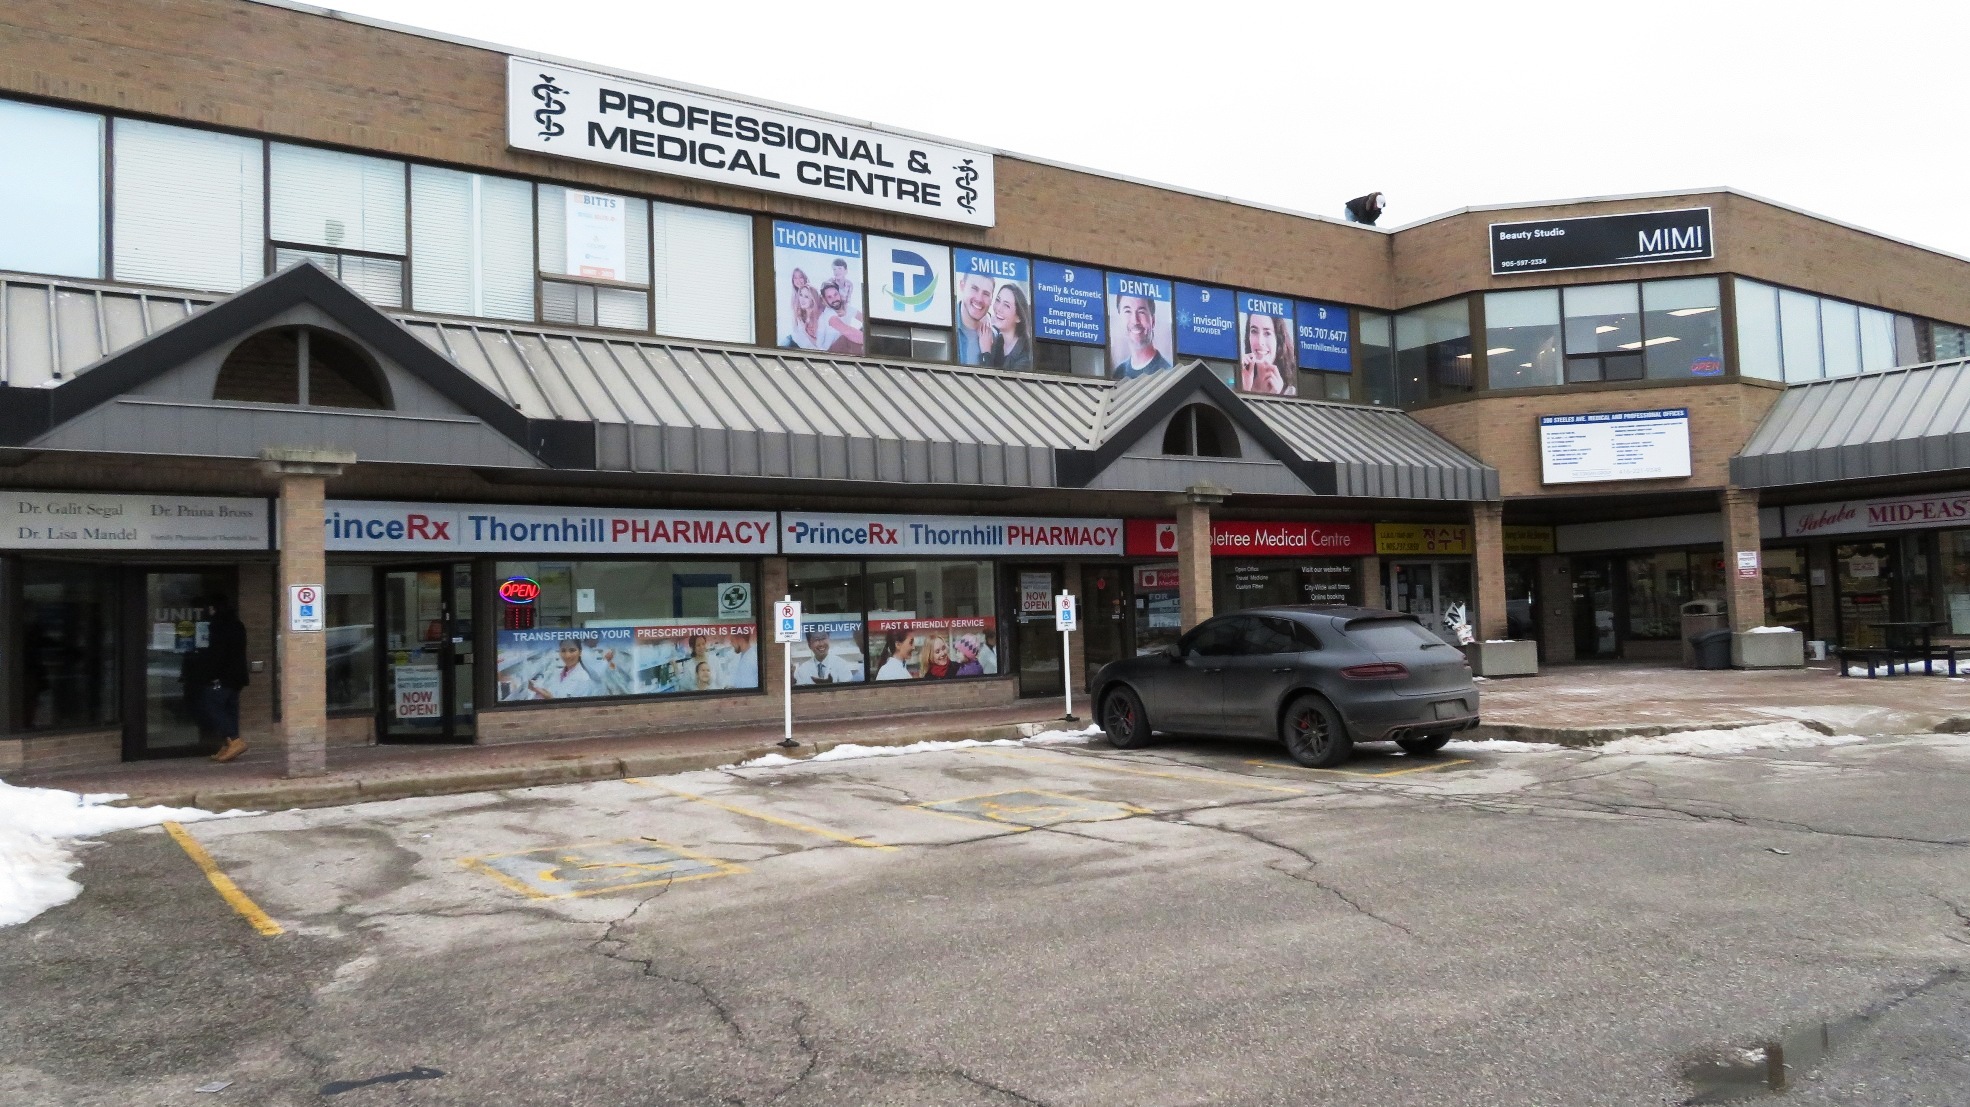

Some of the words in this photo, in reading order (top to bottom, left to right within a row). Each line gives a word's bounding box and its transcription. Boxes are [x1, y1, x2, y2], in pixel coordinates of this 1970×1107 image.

[598, 87, 895, 168] PROFESSIONAL
[907, 150, 932, 175] &
[588, 121, 781, 179] MEDICAL
[796, 161, 942, 207] CENTRE
[583, 195, 617, 209] BITTS
[776, 227, 859, 255] THORNHILL
[1500, 230, 1532, 241] Beauty
[1534, 227, 1565, 238] Studio
[1638, 225, 1702, 253] MIMI
[971, 256, 1016, 277] SMILES
[1038, 283, 1062, 294] Family
[1070, 288, 1102, 299] Cosmetic
[1120, 279, 1162, 298] DENTAL
[1054, 295, 1087, 308] Dentistry
[1248, 298, 1284, 316] CENTRE
[1048, 308, 1093, 320] Emergencies
[1043, 316, 1067, 326] Dental
[1068, 320, 1099, 331] Implants
[1193, 314, 1232, 330] invisalign
[1044, 326, 1064, 336] Laser
[1066, 328, 1098, 342] Dentistry
[1193, 326, 1221, 336] PROVIDER
[1300, 325, 1347, 342] 905.707.6477
[1300, 340, 1347, 354] Thornhillsmiles.ca
[19, 502, 42, 515] Dr.
[47, 503, 82, 516] Galit
[87, 504, 123, 518] Segal
[151, 504, 172, 517] Dr.
[1868, 499, 1970, 523] MID-EAS
[19, 527, 41, 539] Dr.
[48, 527, 77, 540] Lisa
[83, 528, 137, 540] Mandel
[468, 515, 604, 543] Thornhill
[611, 519, 771, 544] PHARMACY
[789, 521, 898, 545] PrinceRx
[910, 523, 1002, 546] Thornhill
[1008, 526, 1118, 546] PHARMACY
[1254, 528, 1307, 546] Medical
[1311, 530, 1350, 546] Centre
[502, 584, 536, 596] OPEN
[1026, 591, 1046, 600] NOW
[1024, 600, 1050, 610] OPEN!
[818, 622, 861, 632] DELIVERY
[880, 621, 901, 630] FAST
[903, 621, 910, 630] &
[912, 619, 950, 629] FRIENDLY
[951, 618, 984, 628] SERVICE
[513, 630, 598, 642] TRANSFERRING
[600, 630, 630, 639] YOUR
[638, 627, 716, 638] PRESCRIPTIONS
[719, 627, 727, 635] IS
[730, 626, 756, 635] EASY
[402, 692, 432, 703] NOW
[400, 704, 437, 716] OPEN!
